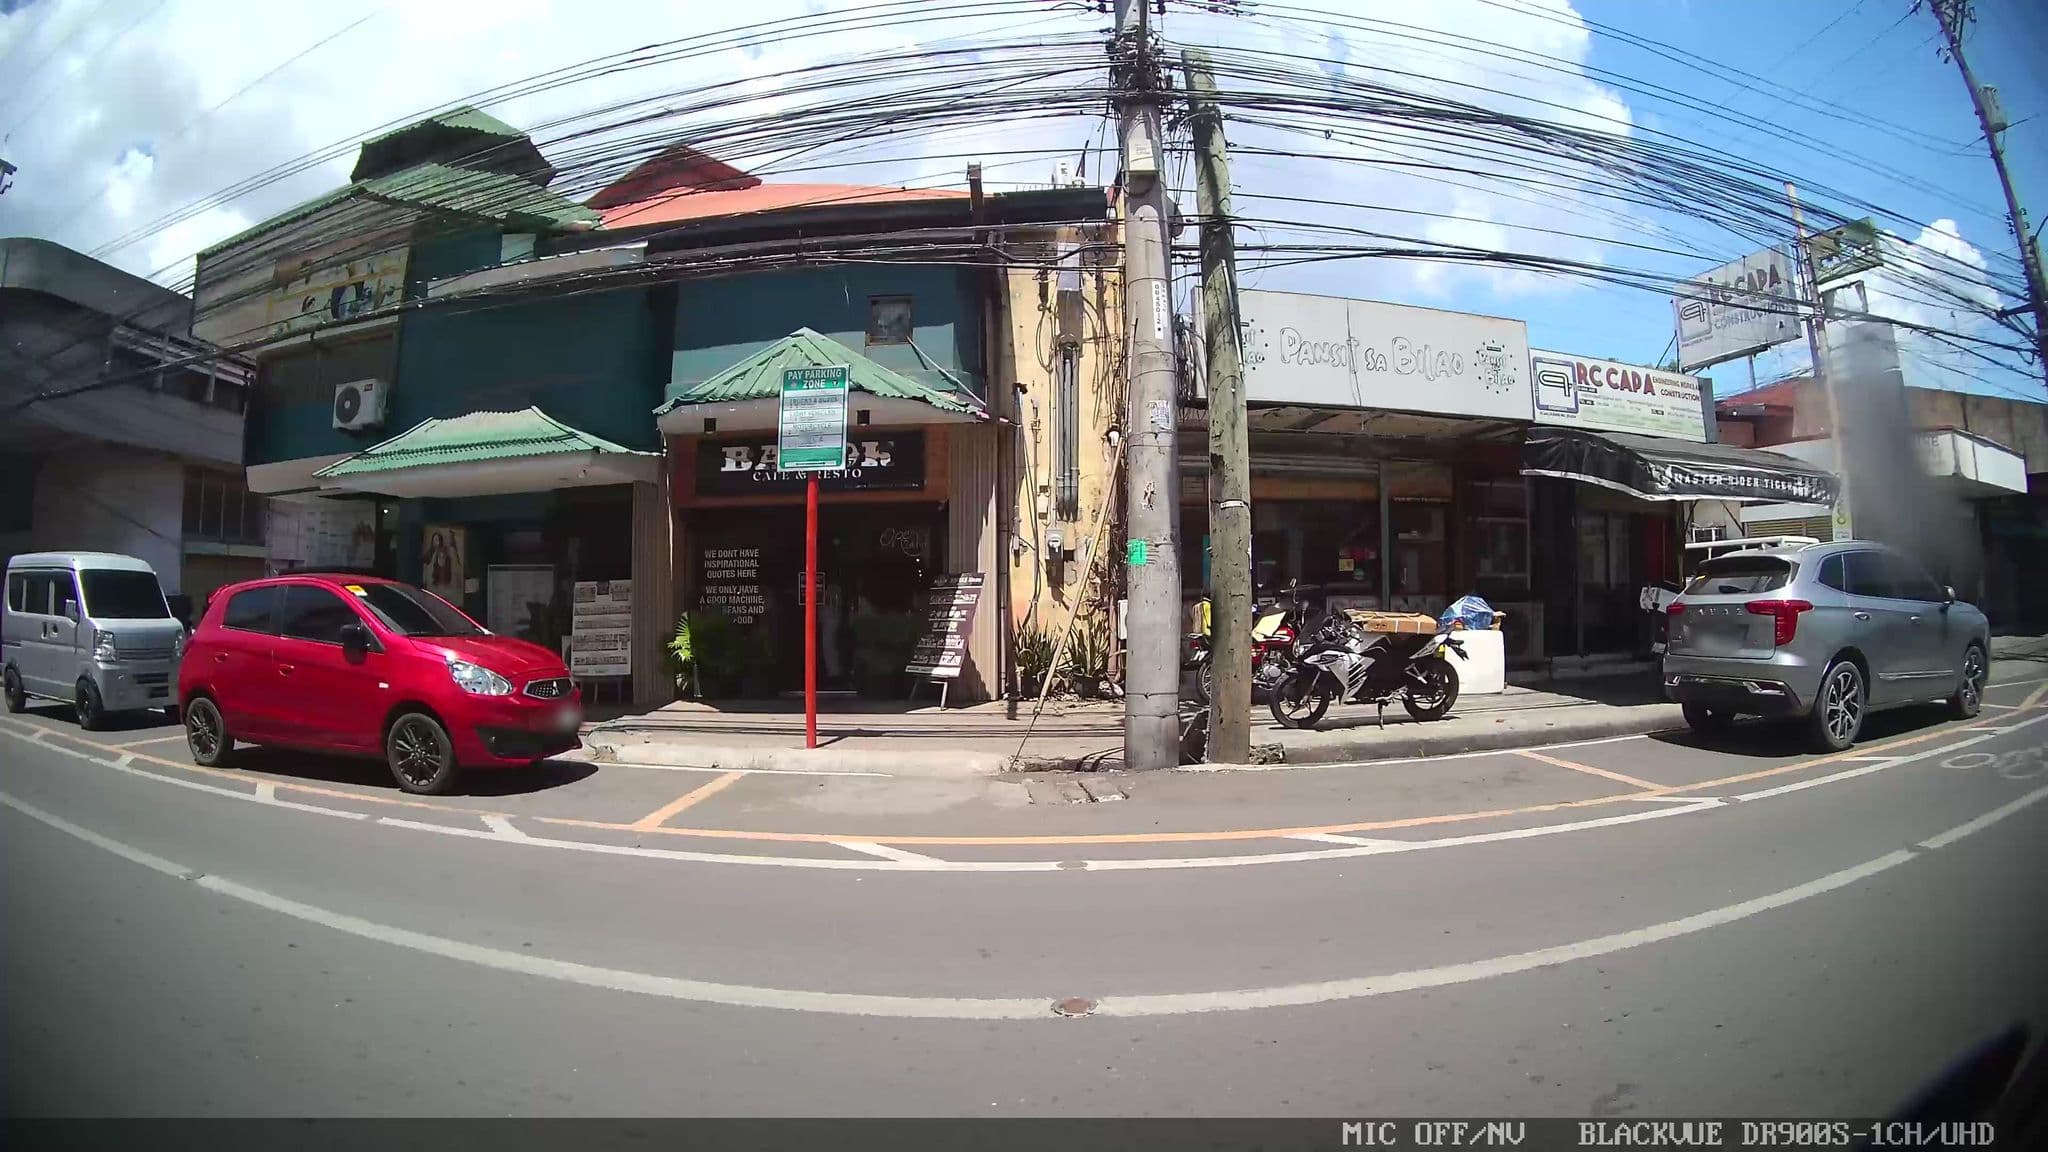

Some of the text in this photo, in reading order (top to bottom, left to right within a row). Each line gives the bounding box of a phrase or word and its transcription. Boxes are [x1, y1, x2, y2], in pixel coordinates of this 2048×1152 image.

[788, 369, 842, 380] PAY PARKING
[1576, 362, 1656, 396] RC CAPA
[803, 379, 826, 389] ZONE
[1661, 388, 1700, 401] CONSTRUCTION
[705, 550, 717, 558] WE
[740, 549, 760, 557] HAVE
[705, 560, 760, 568] INSPIRATIONAL
[707, 569, 757, 578] QUOTES HERE
[719, 585, 737, 593] ONLY
[739, 585, 759, 593] HAVE
[700, 596, 705, 604] A
[707, 596, 727, 604] GOOD
